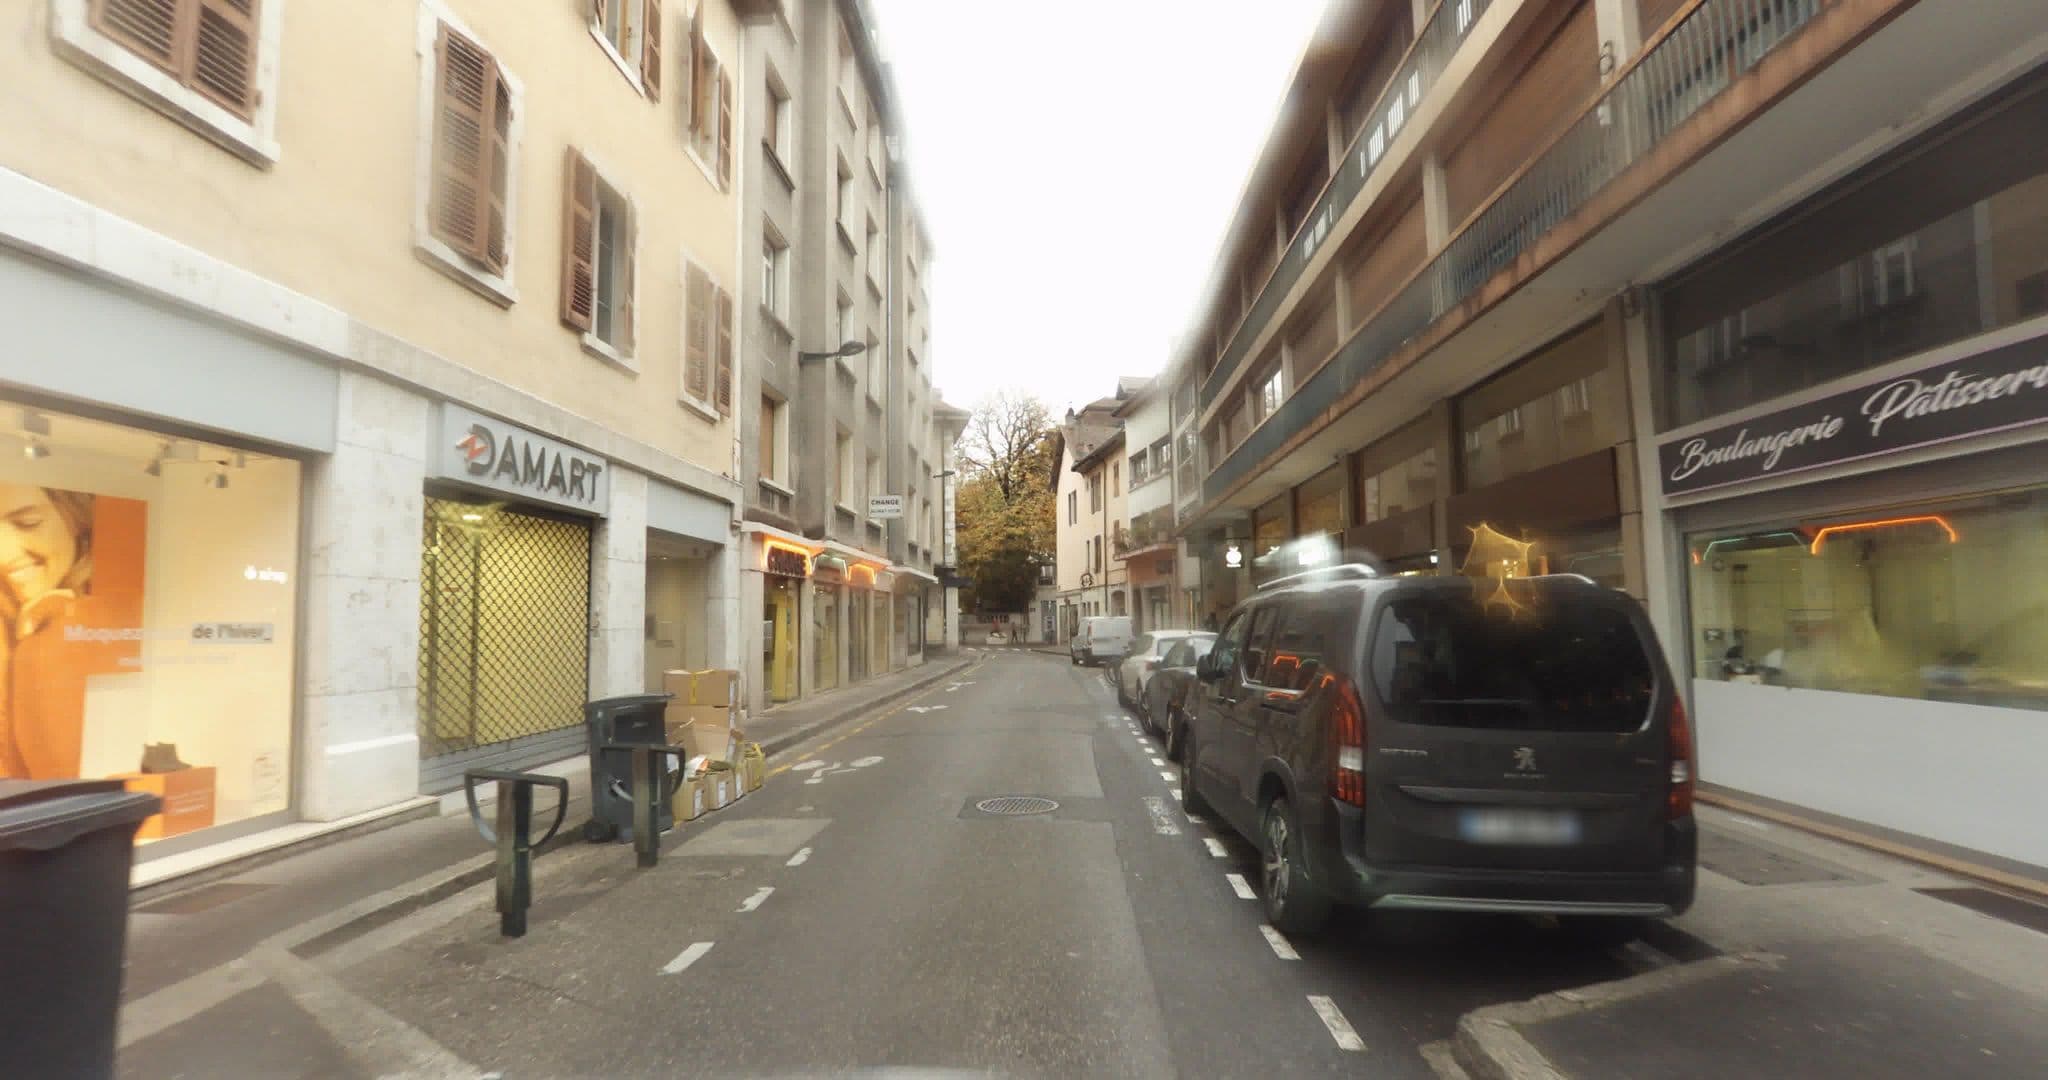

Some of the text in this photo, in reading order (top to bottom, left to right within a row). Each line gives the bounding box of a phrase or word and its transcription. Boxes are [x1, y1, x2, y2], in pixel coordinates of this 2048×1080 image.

[456, 423, 602, 503] DAMART
[1671, 415, 1844, 481] Boulangerie
[192, 624, 213, 639] de
